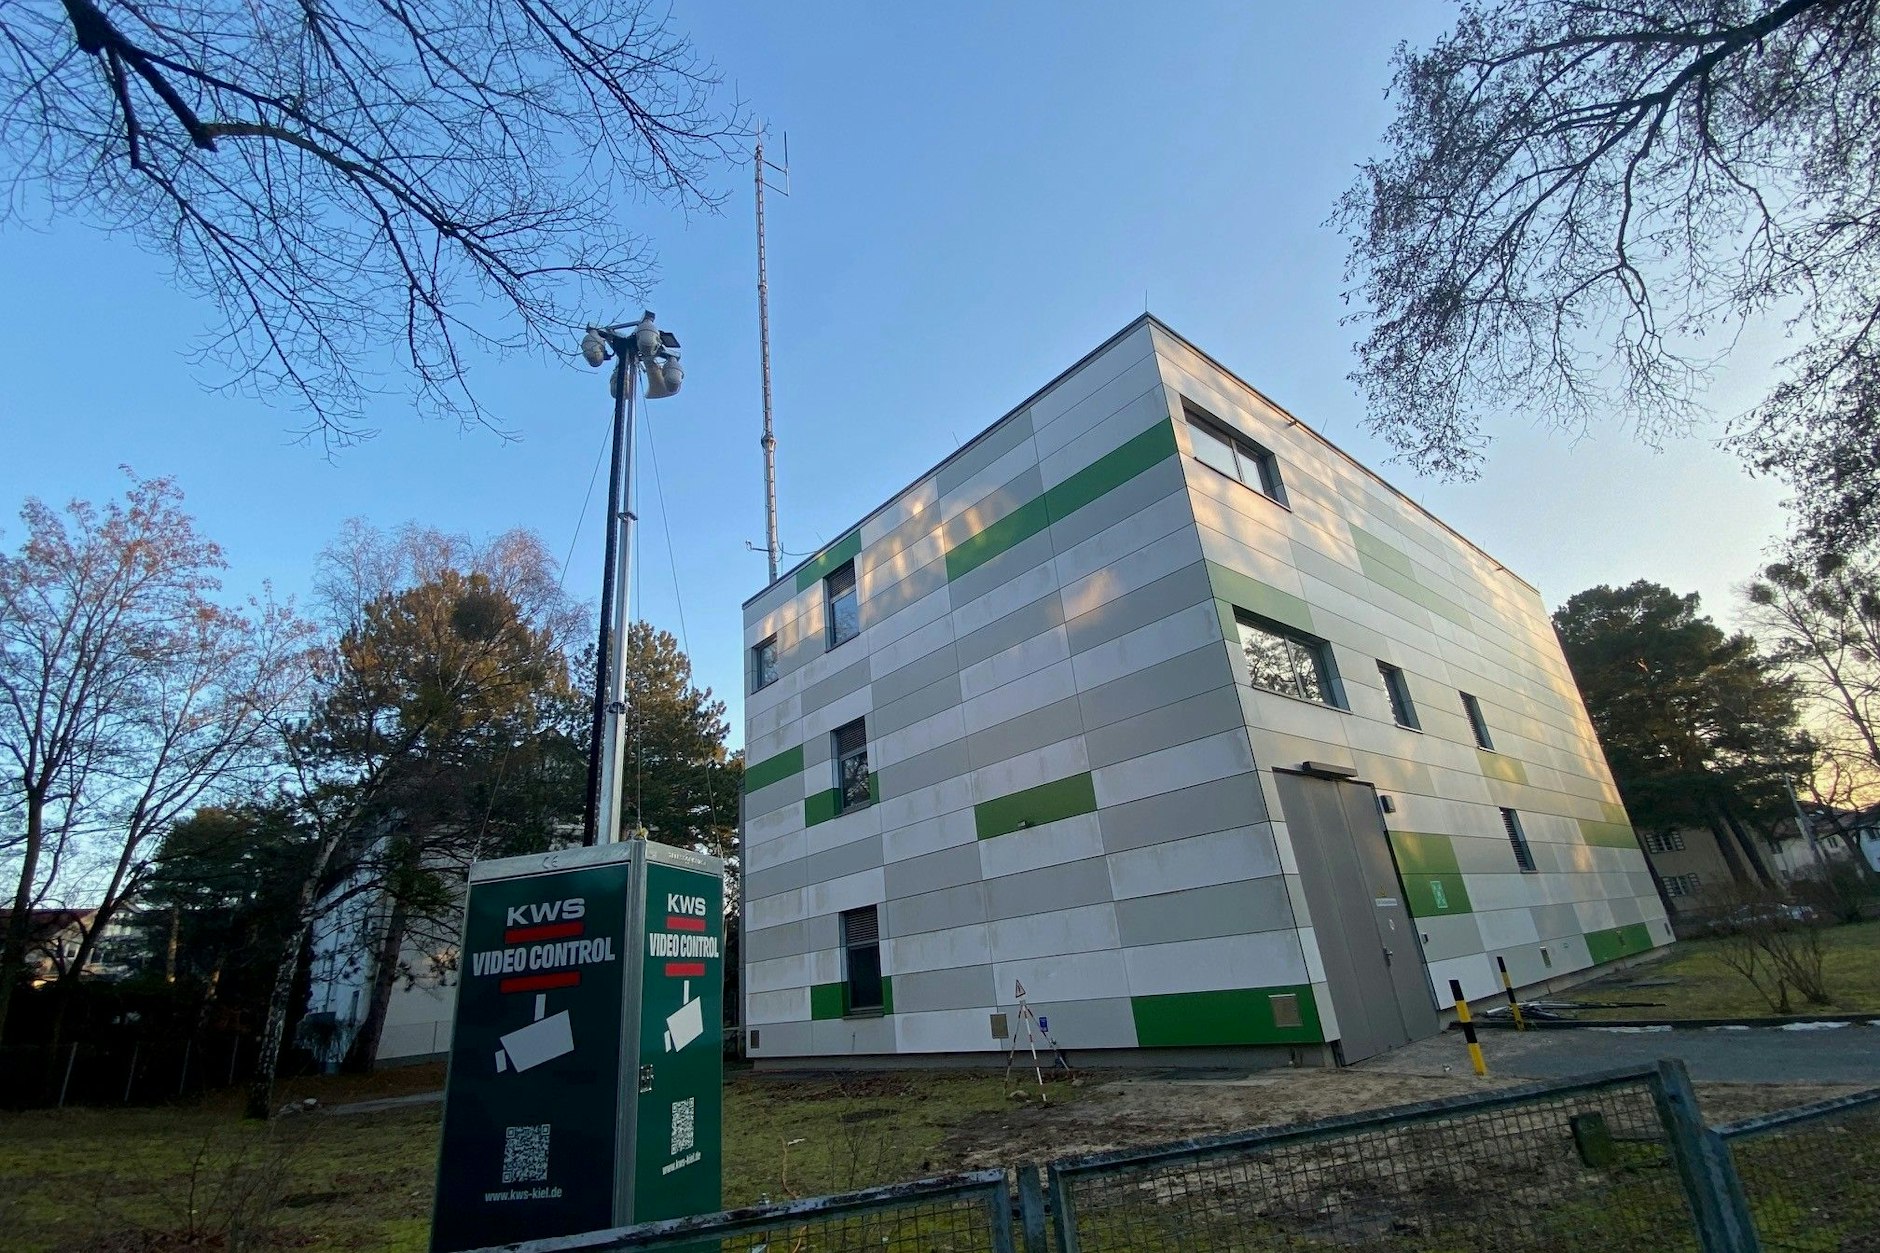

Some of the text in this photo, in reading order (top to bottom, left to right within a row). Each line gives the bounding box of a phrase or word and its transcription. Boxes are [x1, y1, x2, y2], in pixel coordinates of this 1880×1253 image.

[506, 898, 586, 927] KWS
[667, 893, 706, 916] KWS
[472, 937, 616, 976] VIDEO CONTROL
[649, 933, 720, 958] VIDEO CONTROL
[662, 1151, 702, 1176] www.kws-kiel.de
[484, 1186, 563, 1202] www.kws-kiel.de
